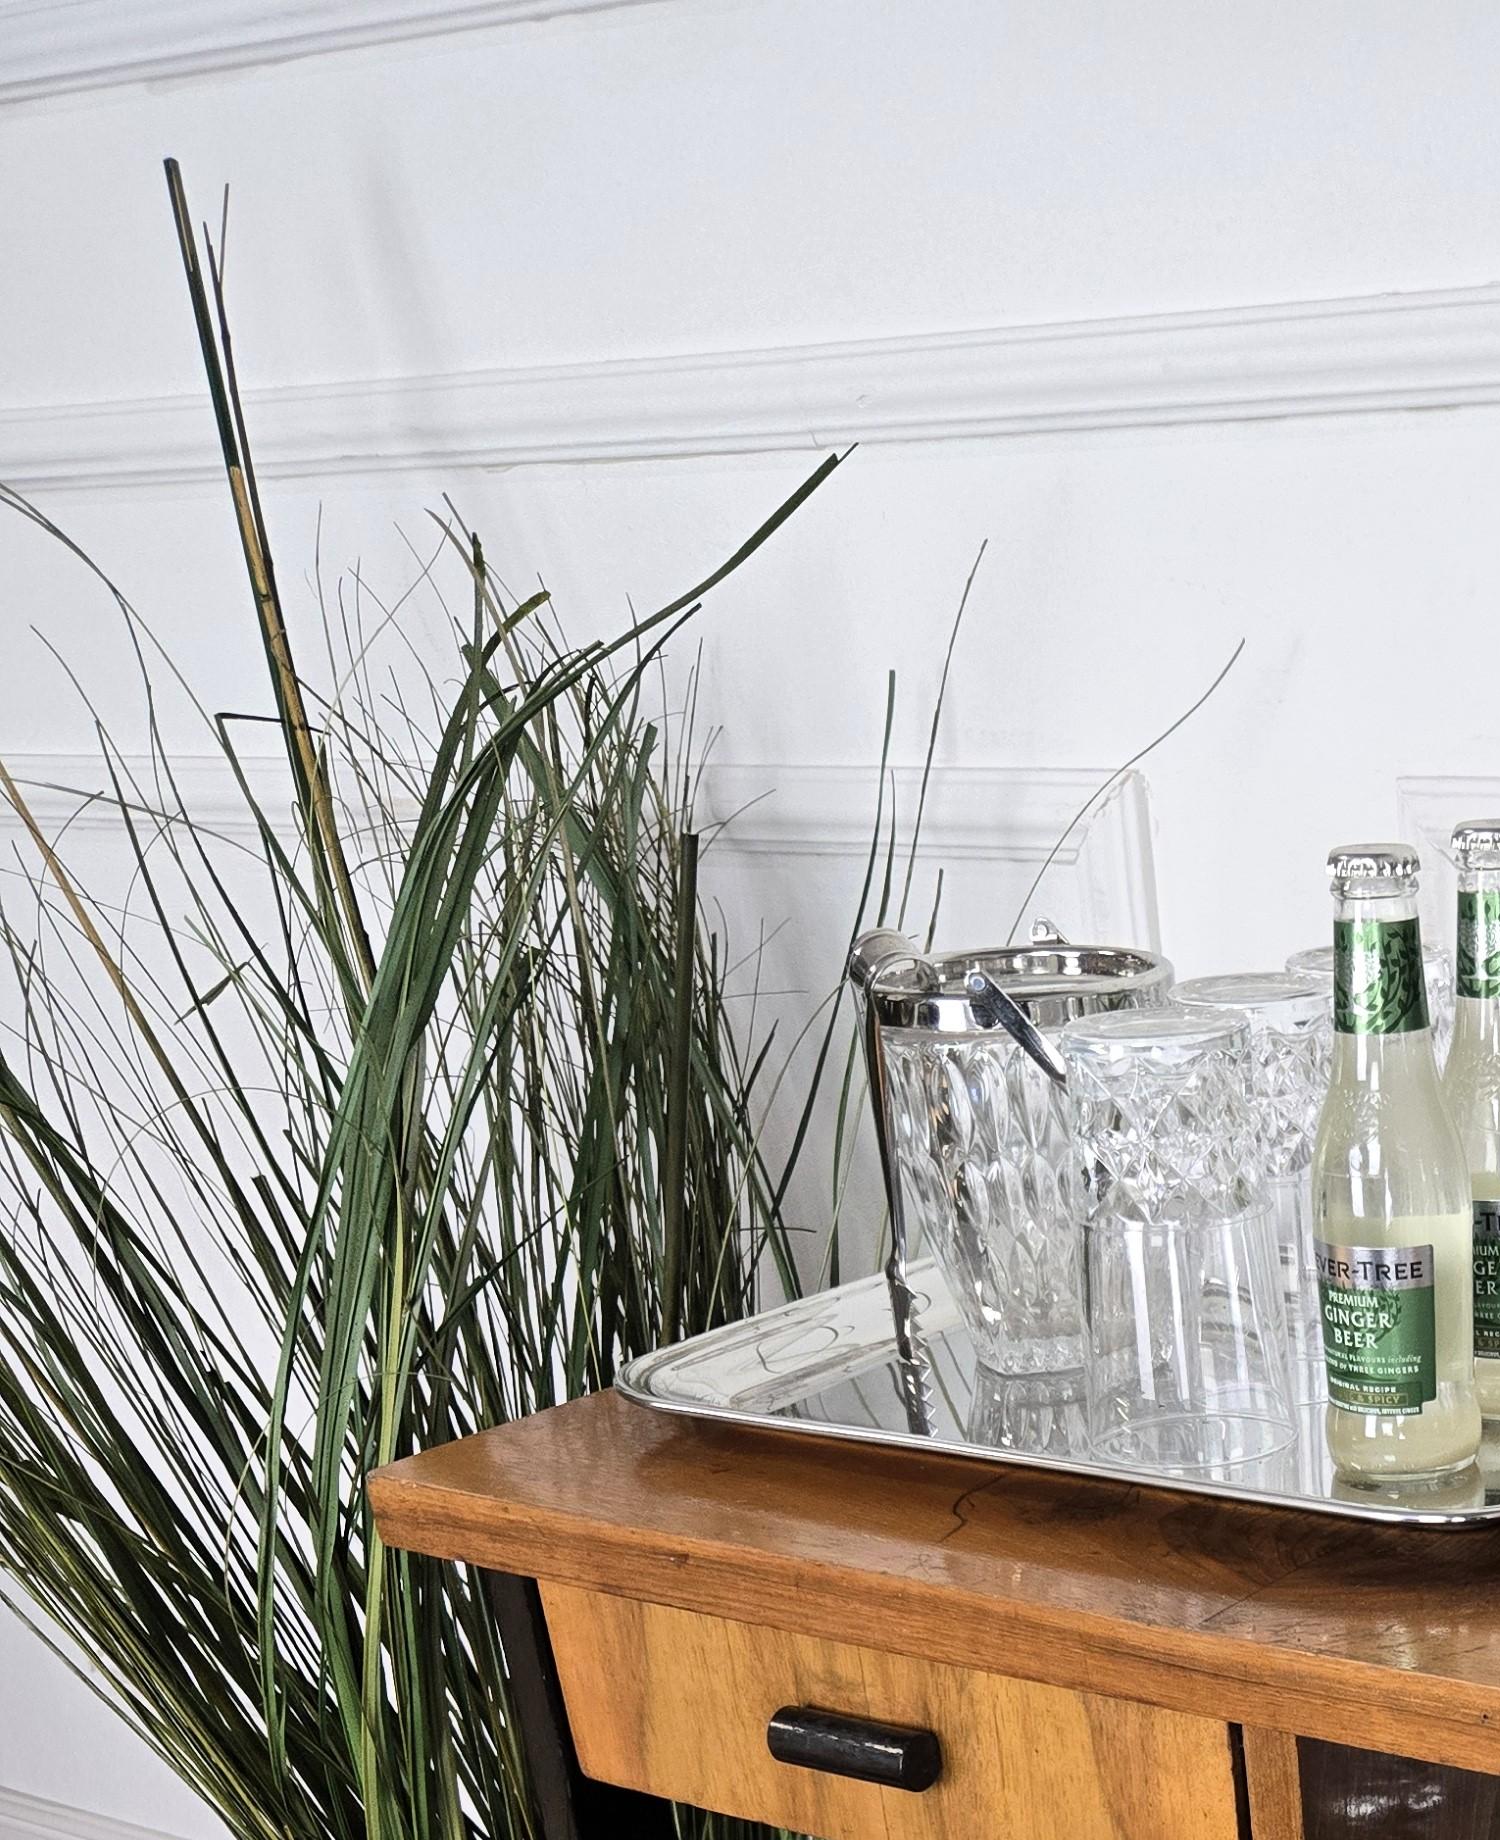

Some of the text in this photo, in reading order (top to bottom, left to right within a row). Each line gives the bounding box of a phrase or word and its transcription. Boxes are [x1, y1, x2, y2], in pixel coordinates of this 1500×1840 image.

[1328, 1289, 1379, 1308] PREMIUM
[1324, 1304, 1392, 1329] GINGER
[1333, 1326, 1379, 1350] BEER
[1376, 1365, 1420, 1375] GINGERS
[1362, 1385, 1397, 1393] RECIPE
[1367, 1395, 1401, 1405] SPICY
